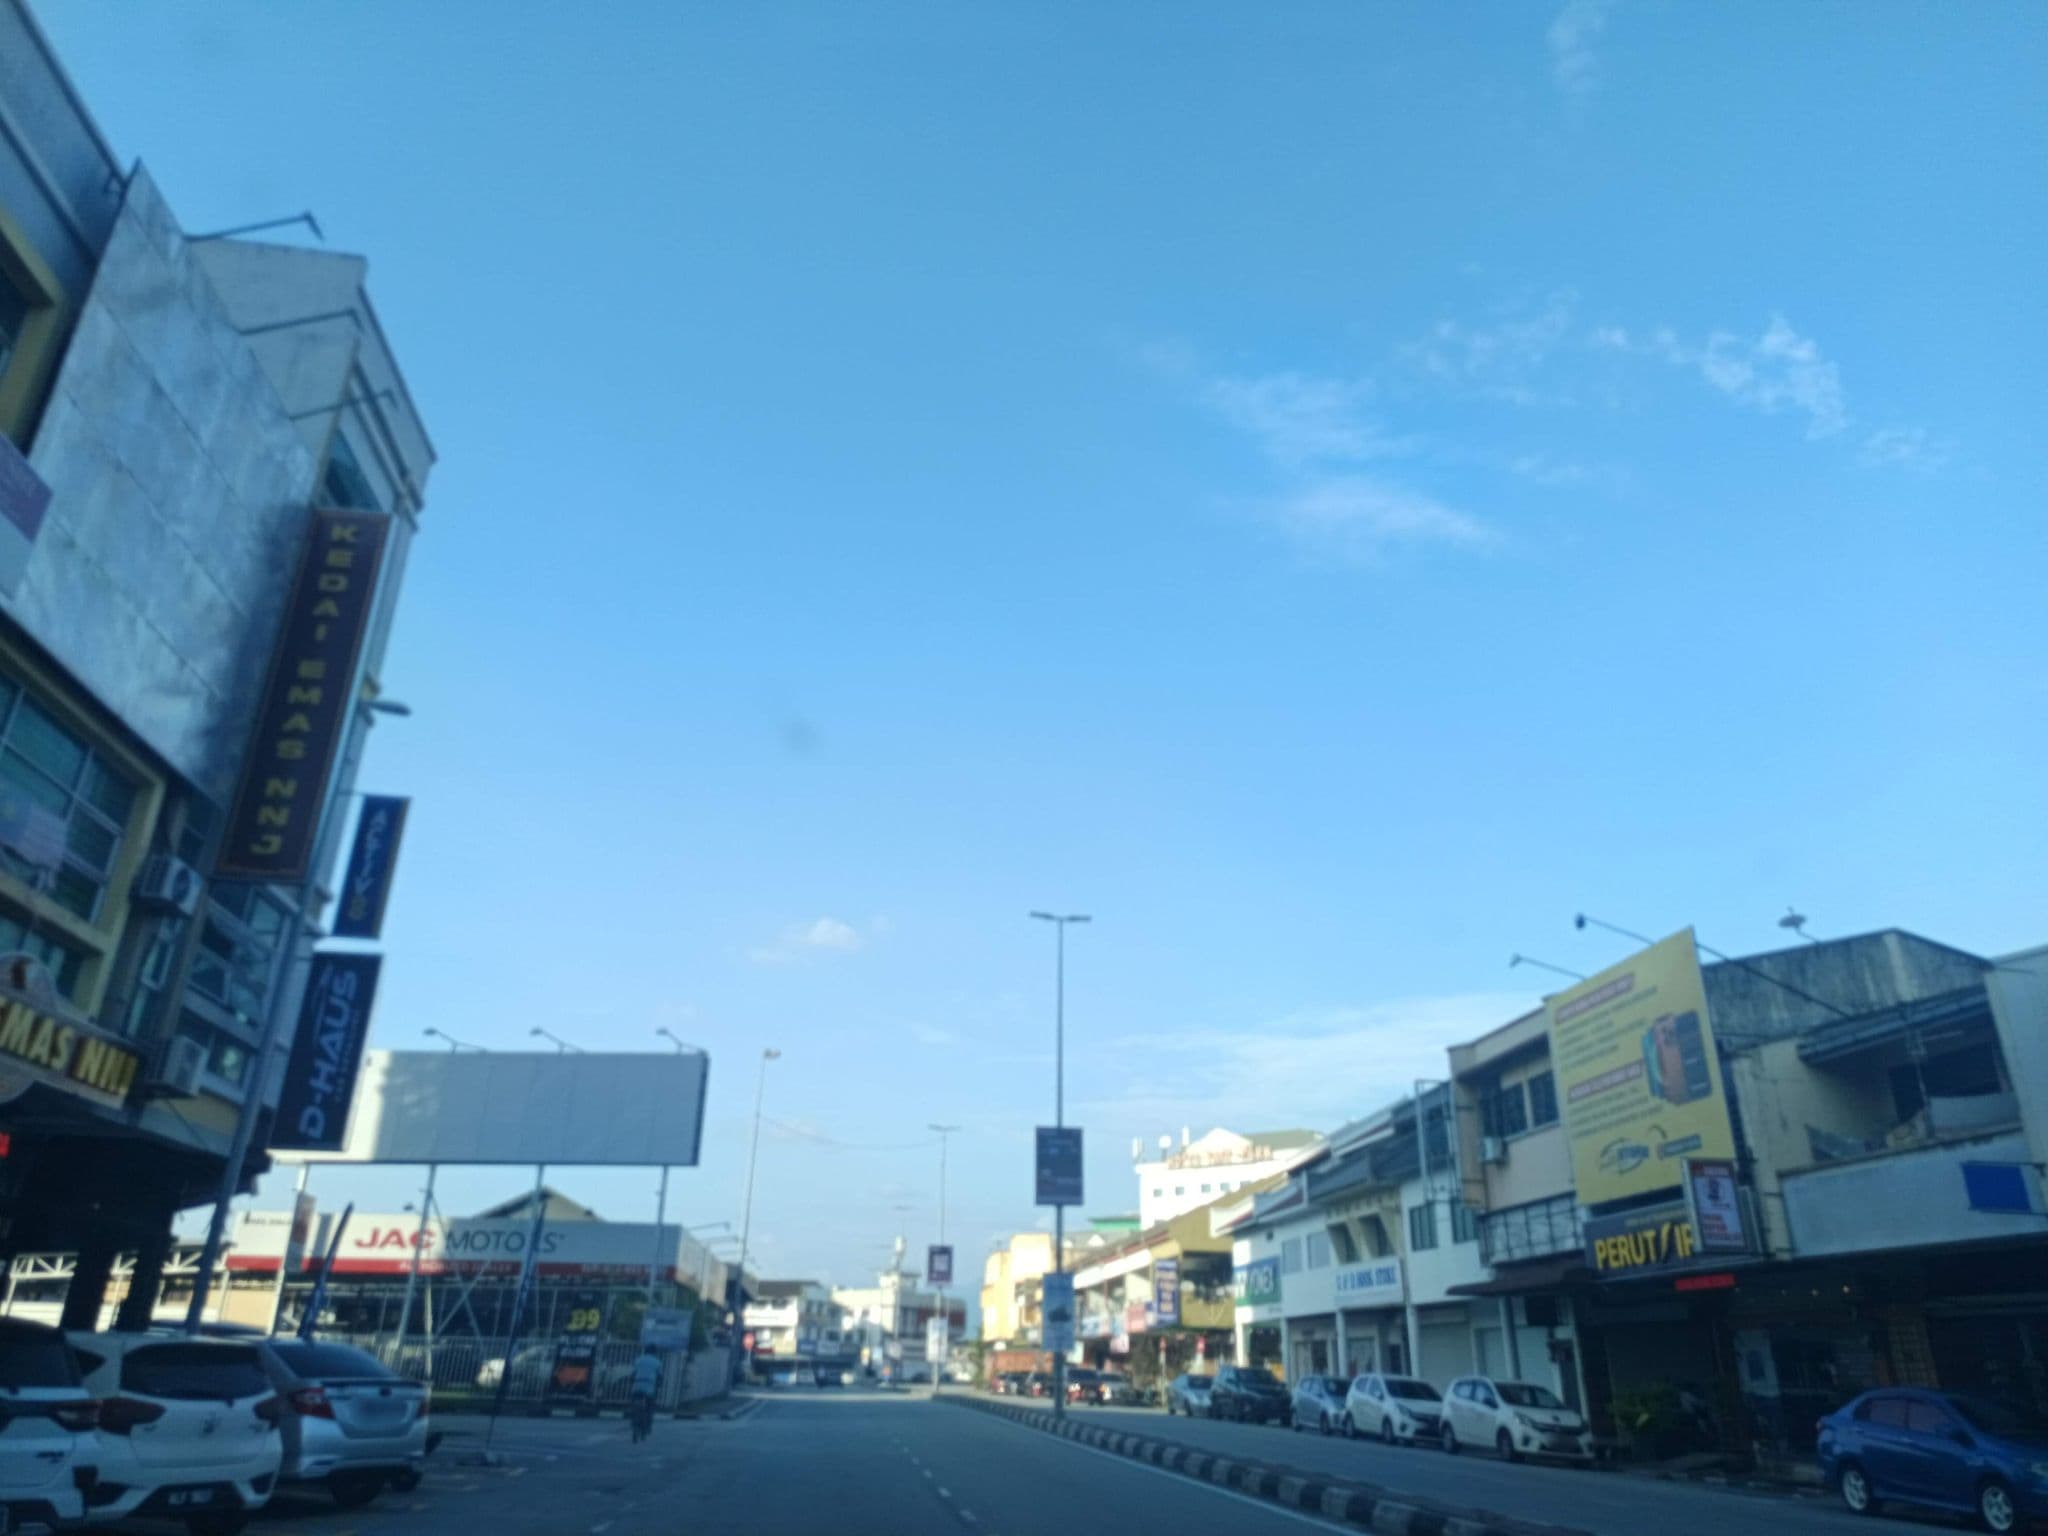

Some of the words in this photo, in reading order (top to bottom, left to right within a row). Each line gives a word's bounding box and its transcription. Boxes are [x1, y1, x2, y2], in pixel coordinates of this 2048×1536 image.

[311, 524, 359, 641] KEDAI
[277, 659, 327, 760] EMAS
[251, 777, 299, 855] NNJ
[0, 995, 76, 1070] MAS
[298, 970, 357, 1139] D-HAUS
[354, 1227, 435, 1249] JAC
[446, 1229, 558, 1253] MOTOS
[1593, 1229, 1657, 1271] PERUT
